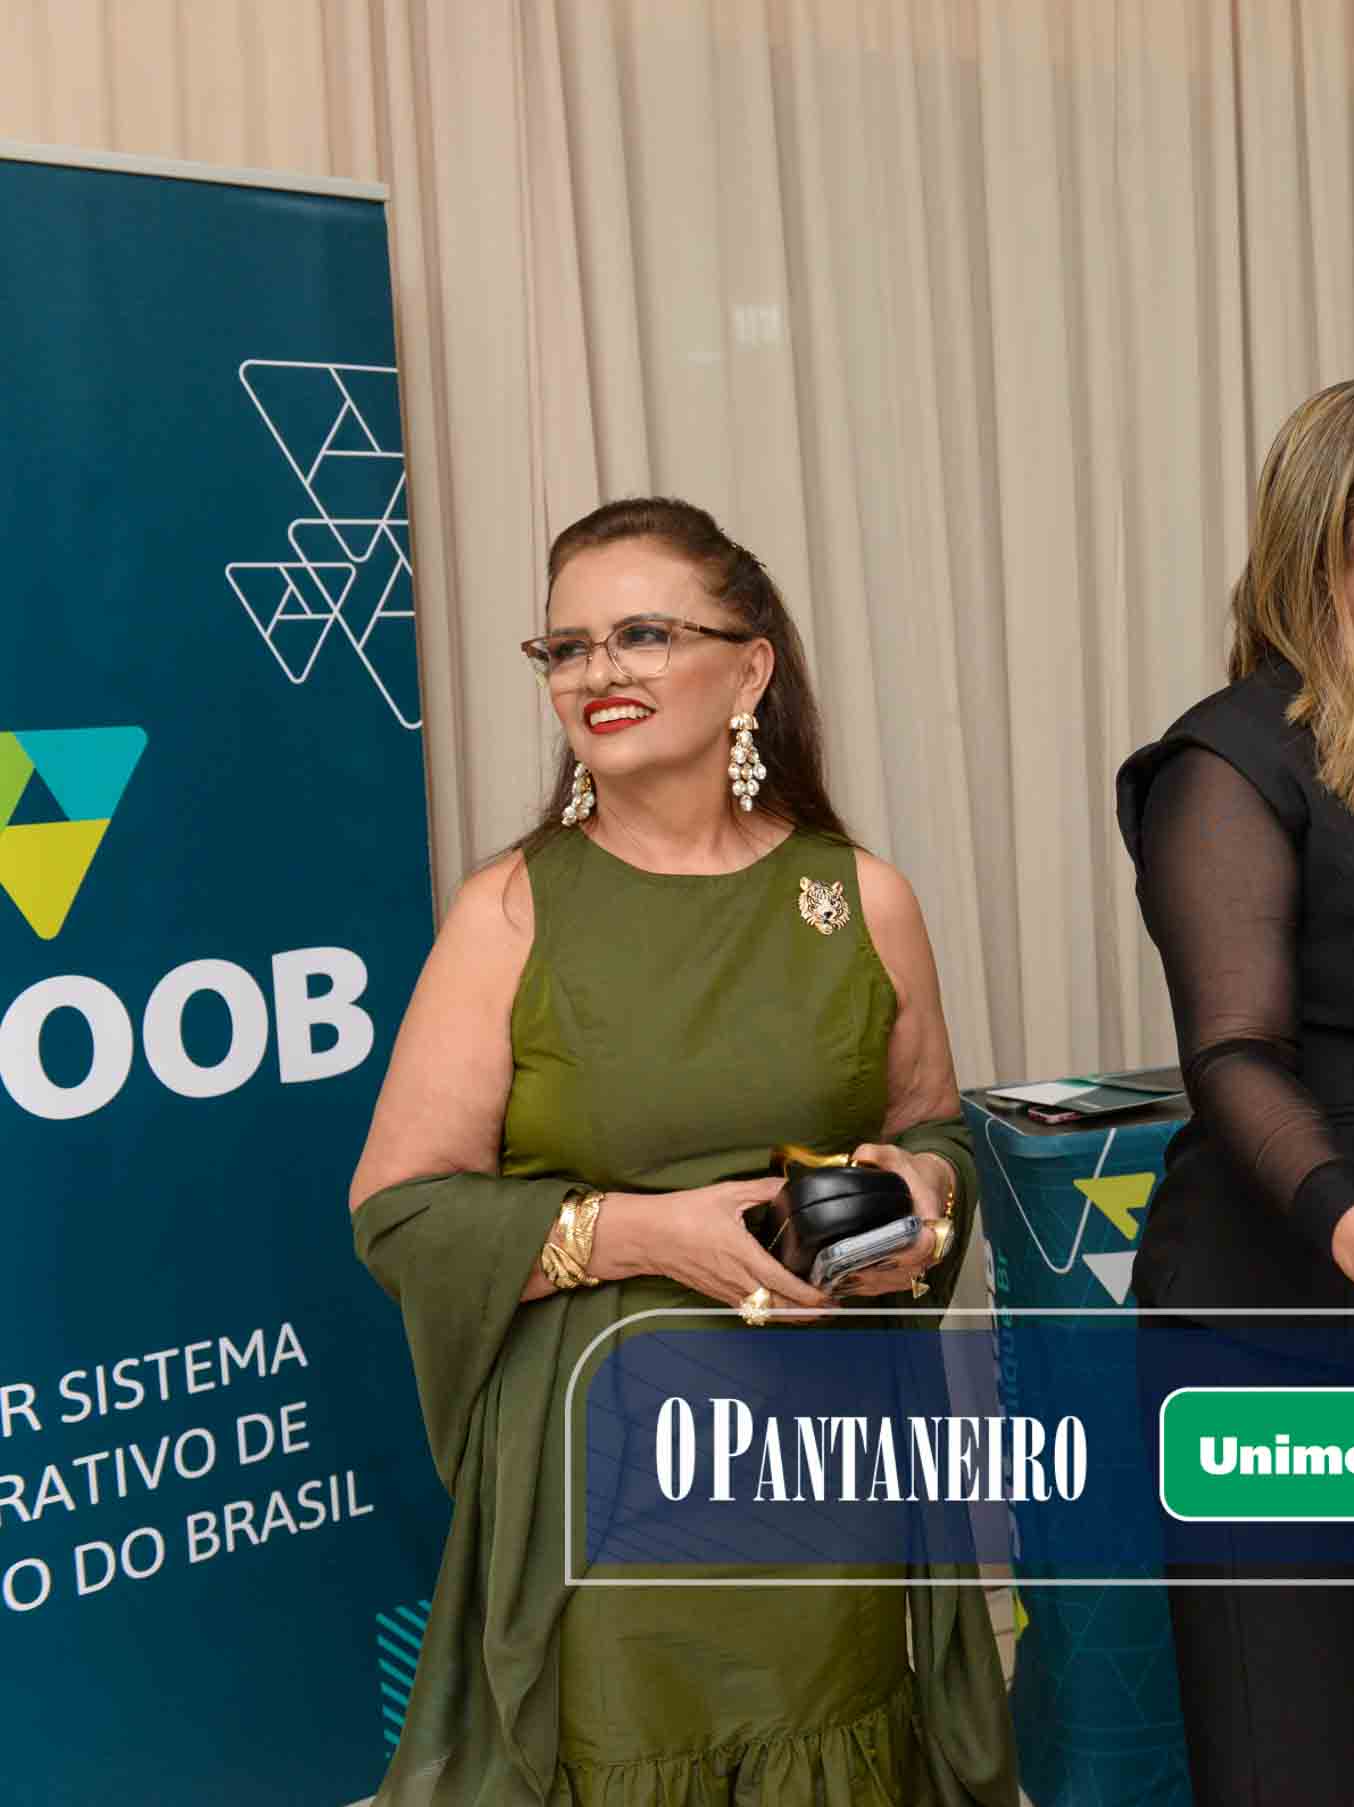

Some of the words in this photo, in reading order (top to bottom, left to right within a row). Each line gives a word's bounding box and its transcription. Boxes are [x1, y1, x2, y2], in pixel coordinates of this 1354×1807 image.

[0, 946, 375, 1120] OOB
[58, 1321, 309, 1424] SISTEMA
[236, 1401, 310, 1465] DE
[74, 1527, 166, 1596] DO
[186, 1470, 374, 1564] BRASIL
